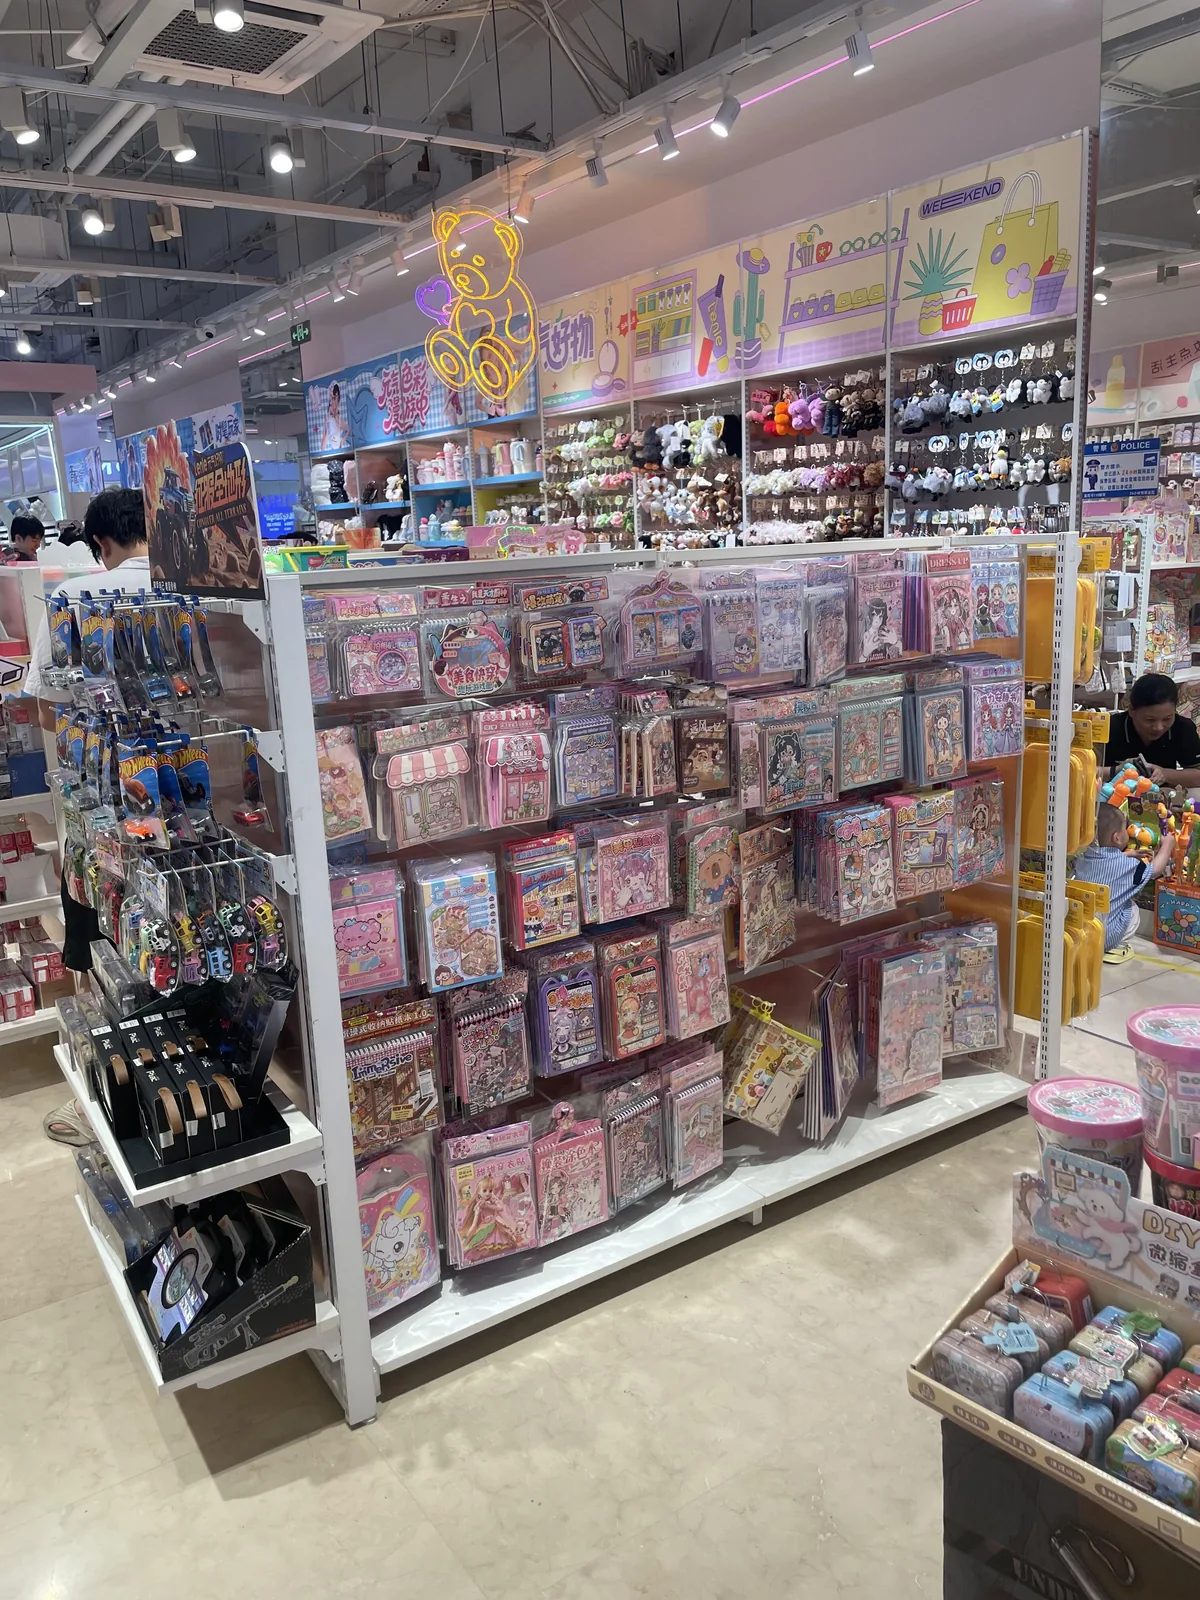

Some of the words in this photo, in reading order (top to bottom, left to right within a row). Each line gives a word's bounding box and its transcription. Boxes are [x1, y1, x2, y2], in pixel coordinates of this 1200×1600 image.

[922, 182, 1001, 215] WEEKEND
[1120, 441, 1151, 451] POLICE
[216, 511, 224, 522] ALL
[957, 556, 969, 566] UP
[440, 592, 468, 606] 重生之
[452, 665, 498, 685] 美食快穿
[130, 755, 157, 774] WHEELS
[476, 1157, 526, 1178] 甜甜穿衣贴
[1142, 1208, 1200, 1250] DIY
